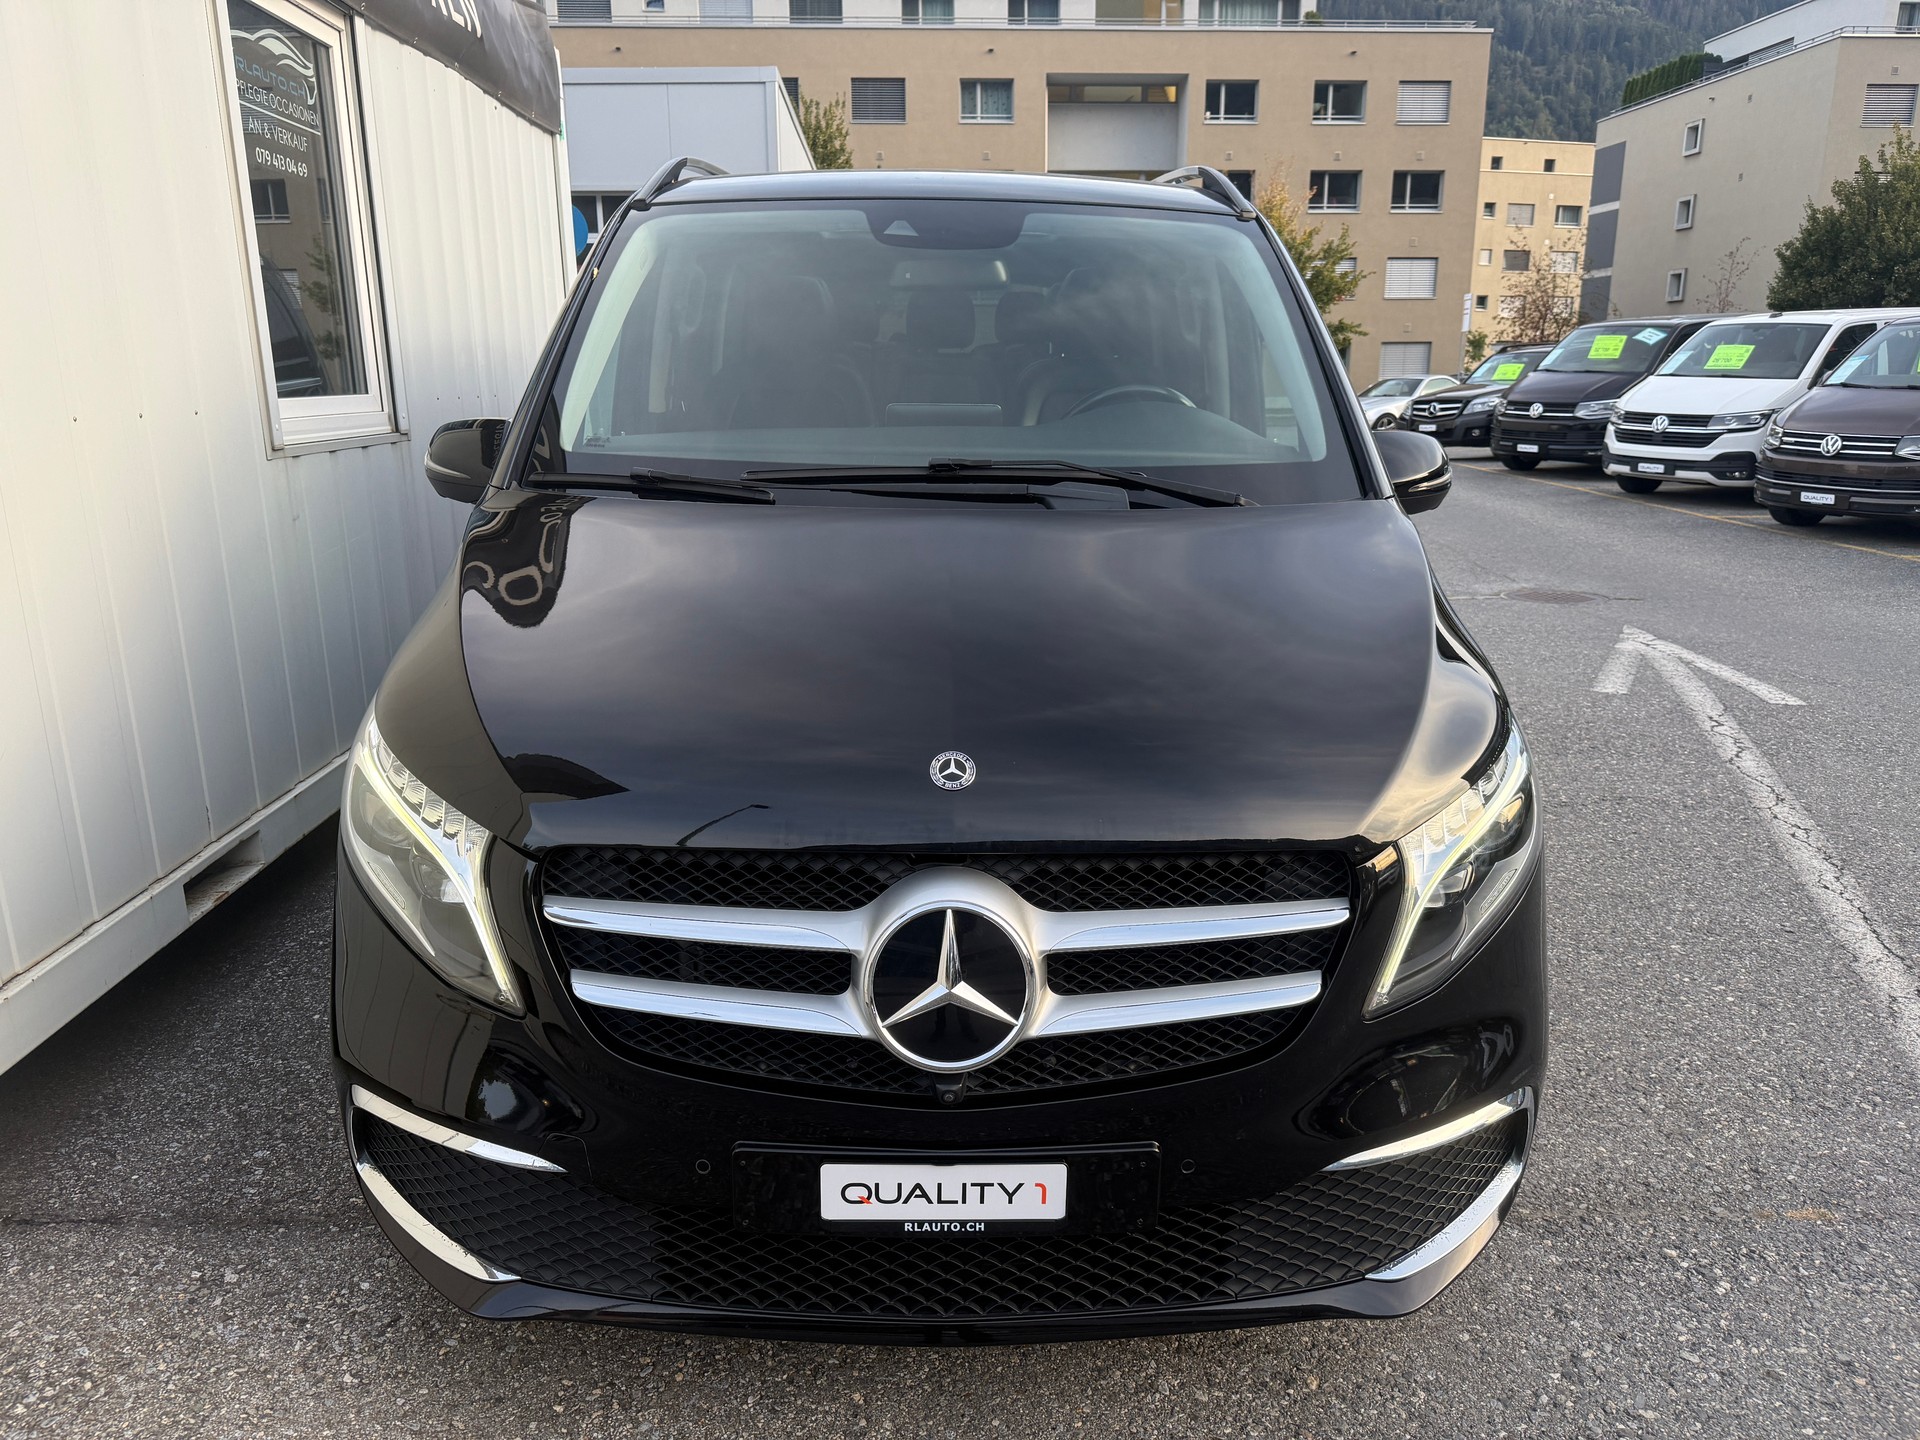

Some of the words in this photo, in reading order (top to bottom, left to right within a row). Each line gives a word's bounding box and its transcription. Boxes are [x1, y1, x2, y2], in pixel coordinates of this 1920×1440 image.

[235, 55, 306, 99] RLAUTO.CH
[269, 93, 320, 126] OCCASIONEN
[248, 116, 262, 135] AN
[264, 122, 271, 139] &
[271, 125, 308, 152] VERKAUF
[255, 147, 271, 166] 079
[272, 153, 285, 171] 413
[286, 157, 297, 175] 04
[297, 162, 308, 177] 69
[1803, 494, 1829, 502] QUALITY
[840, 1182, 1025, 1205] QUALITY
[1034, 1182, 1047, 1205] 1
[904, 1222, 985, 1232] RLAUTO.CH
